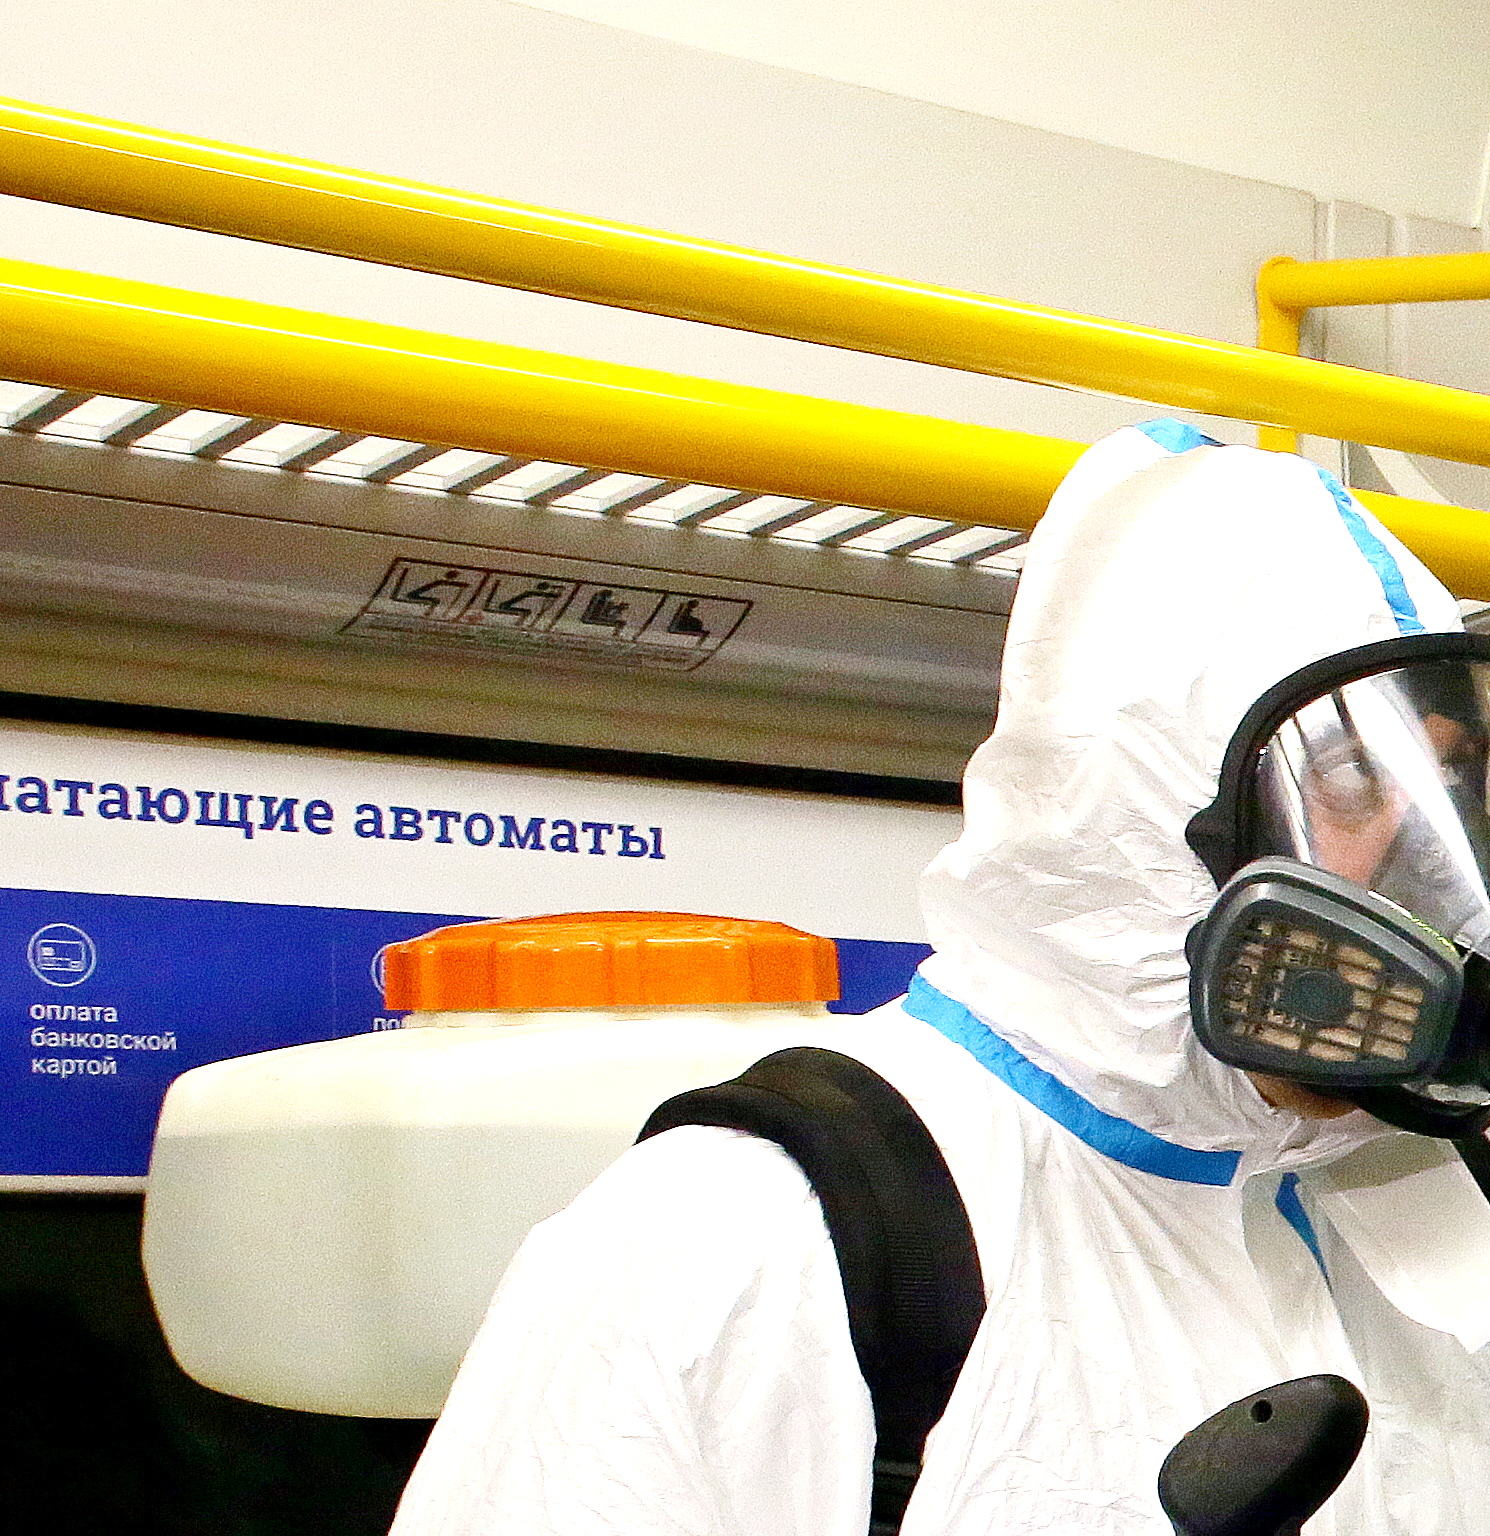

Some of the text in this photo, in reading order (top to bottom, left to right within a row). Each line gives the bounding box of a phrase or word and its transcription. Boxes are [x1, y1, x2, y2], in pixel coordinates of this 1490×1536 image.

[353, 803, 667, 860] автоматы
[30, 1003, 119, 1023] оплата
[30, 1026, 178, 1051] банковской
[31, 1055, 118, 1079] картой
